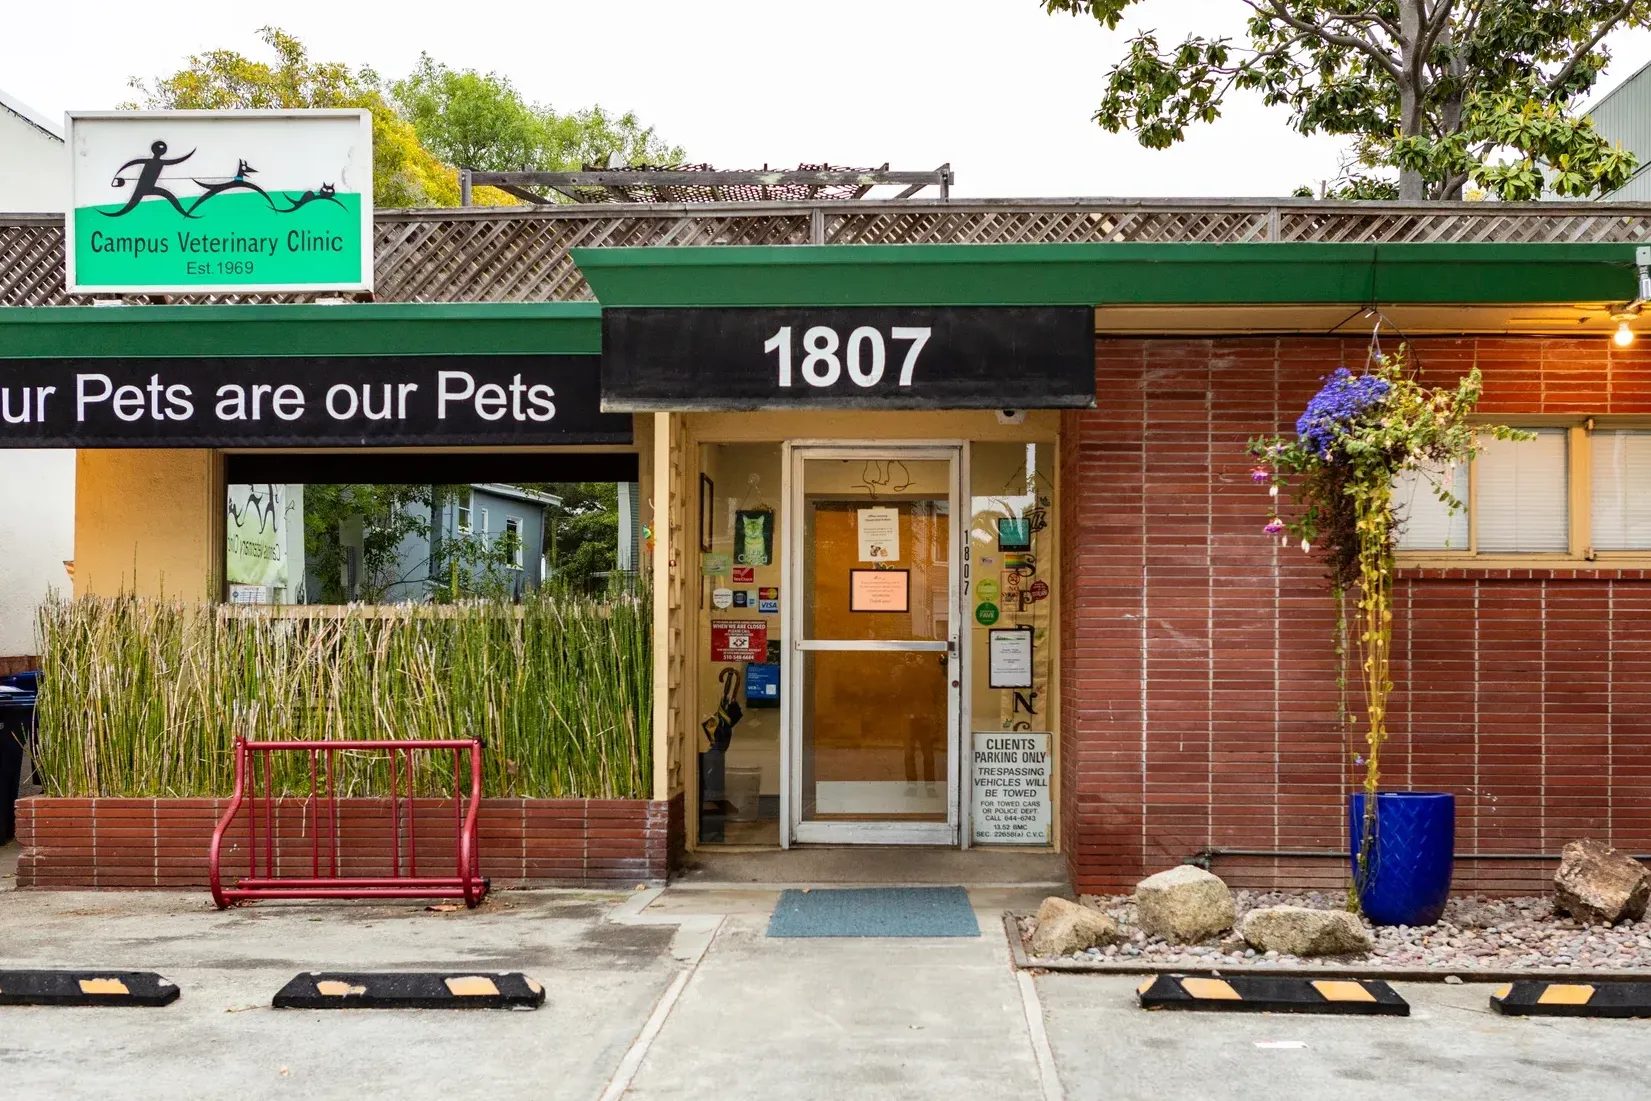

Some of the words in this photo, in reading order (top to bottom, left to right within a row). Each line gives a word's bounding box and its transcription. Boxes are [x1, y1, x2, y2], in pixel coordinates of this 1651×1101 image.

[91, 230, 169, 258] Campus
[177, 231, 279, 256] Veterinary
[287, 229, 343, 252] Clinic
[217, 261, 254, 275] 1969
[764, 326, 931, 387] 1807
[77, 373, 194, 422] Pets
[215, 383, 305, 422] are
[325, 382, 418, 421] our
[438, 371, 556, 421] Pets
[986, 739, 1035, 750] CLIENTS
[974, 752, 1018, 763] PARKING
[1022, 752, 1047, 763] ONLY
[978, 768, 1045, 776] TRESPASSING
[974, 779, 1021, 787] VEHICLES
[1026, 779, 1048, 787] WILL
[985, 789, 998, 797] BE
[1003, 789, 1037, 797] TOWED
